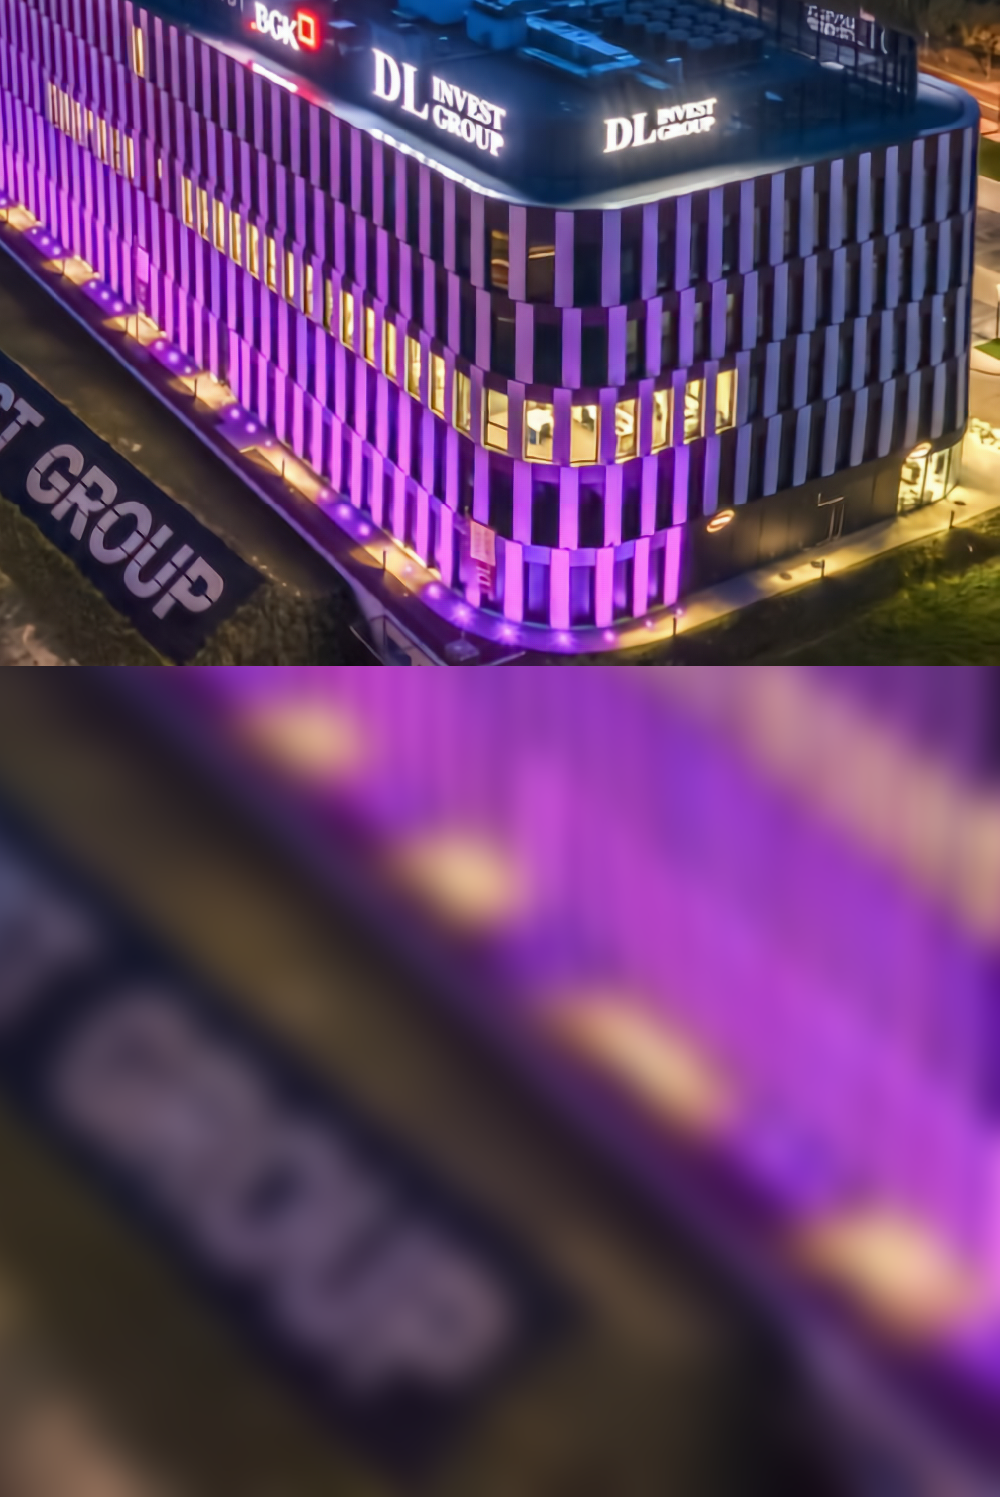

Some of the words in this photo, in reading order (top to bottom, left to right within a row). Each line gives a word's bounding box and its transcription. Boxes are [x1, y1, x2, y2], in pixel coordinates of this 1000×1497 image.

[255, 2, 300, 51] BGK
[373, 49, 429, 120] DL
[432, 76, 507, 131] INVEST
[432, 105, 505, 157] GROUP
[603, 112, 657, 153] DL
[657, 98, 718, 125] INVEST
[657, 116, 716, 141] GROUP
[25, 444, 224, 619] GROUP
